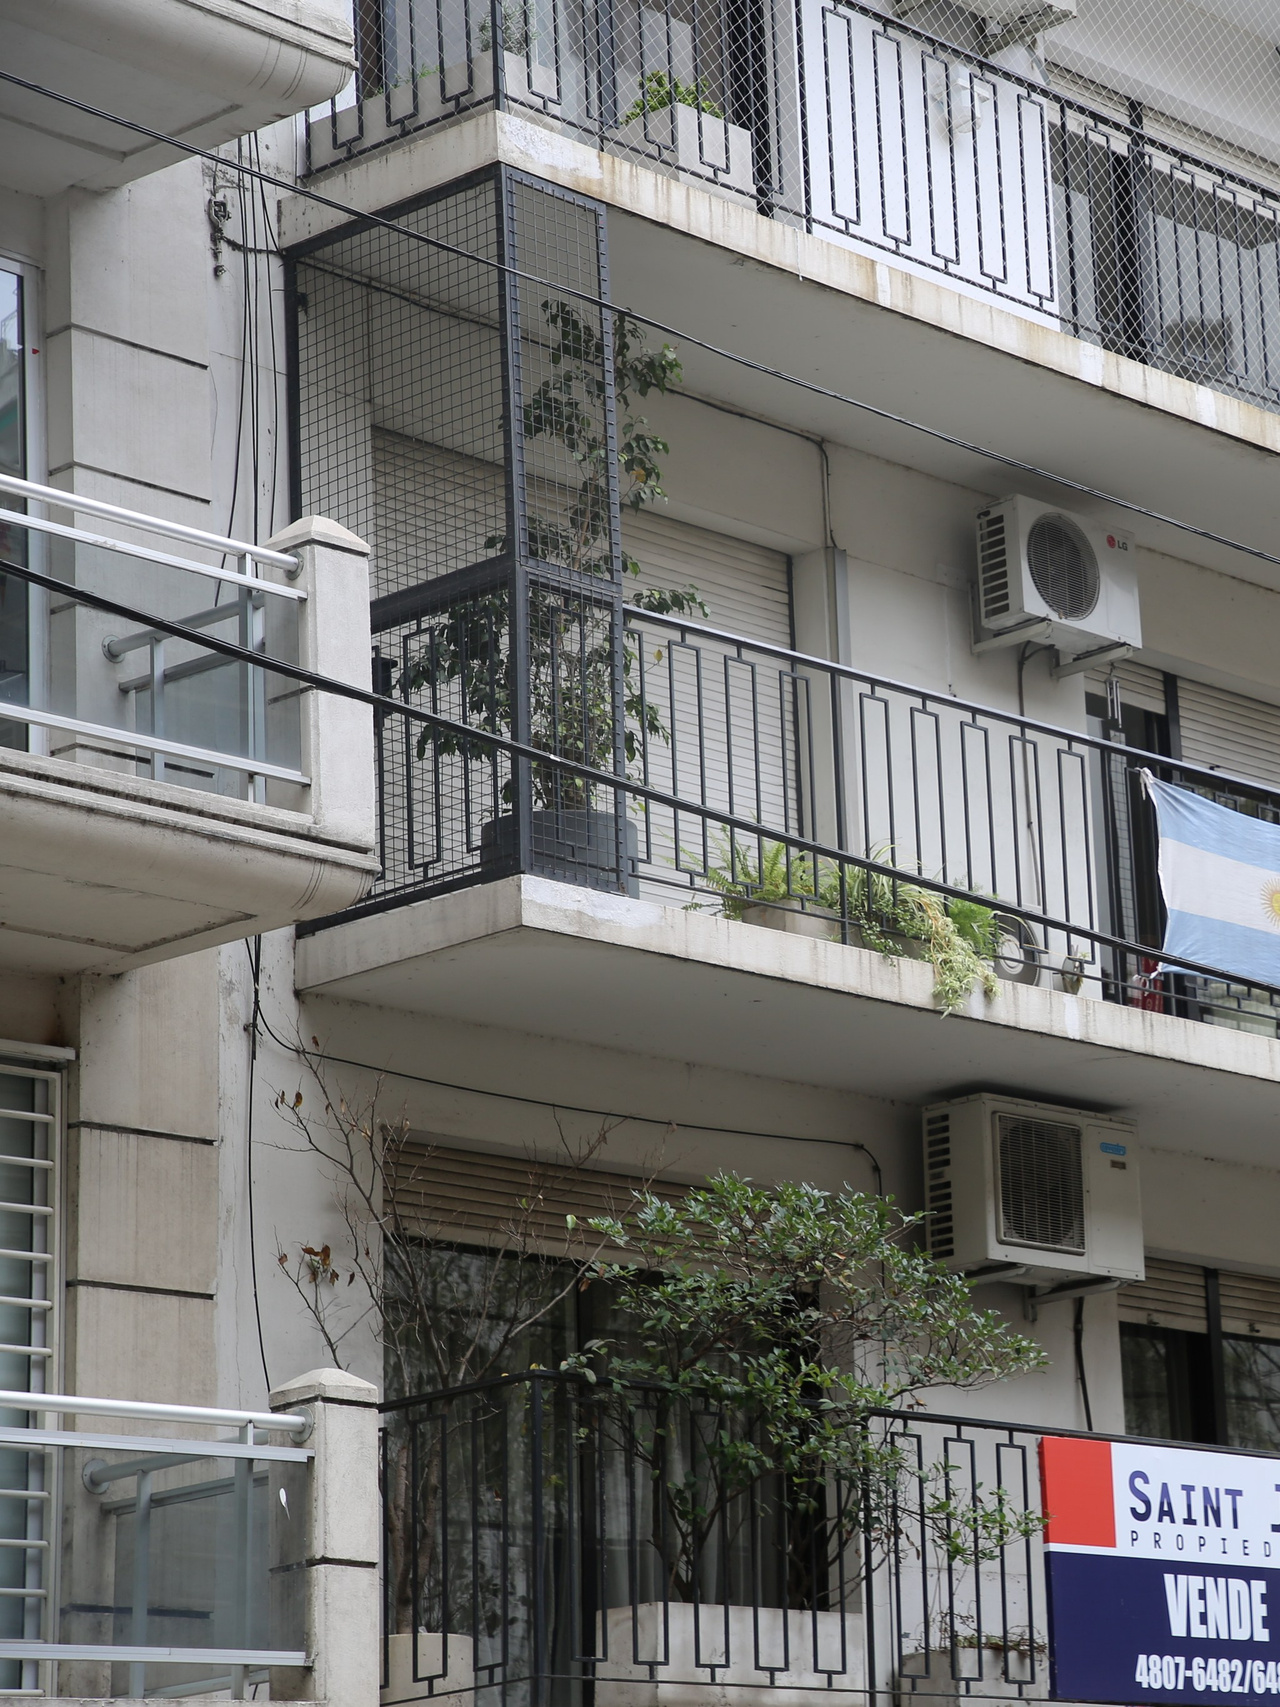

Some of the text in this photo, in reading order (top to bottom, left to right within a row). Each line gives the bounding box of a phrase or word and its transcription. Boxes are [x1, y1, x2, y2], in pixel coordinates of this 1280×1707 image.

[1117, 540, 1128, 551] LG
[1128, 1470, 1243, 1529] SAINT
[1163, 1573, 1270, 1642] VENDE
